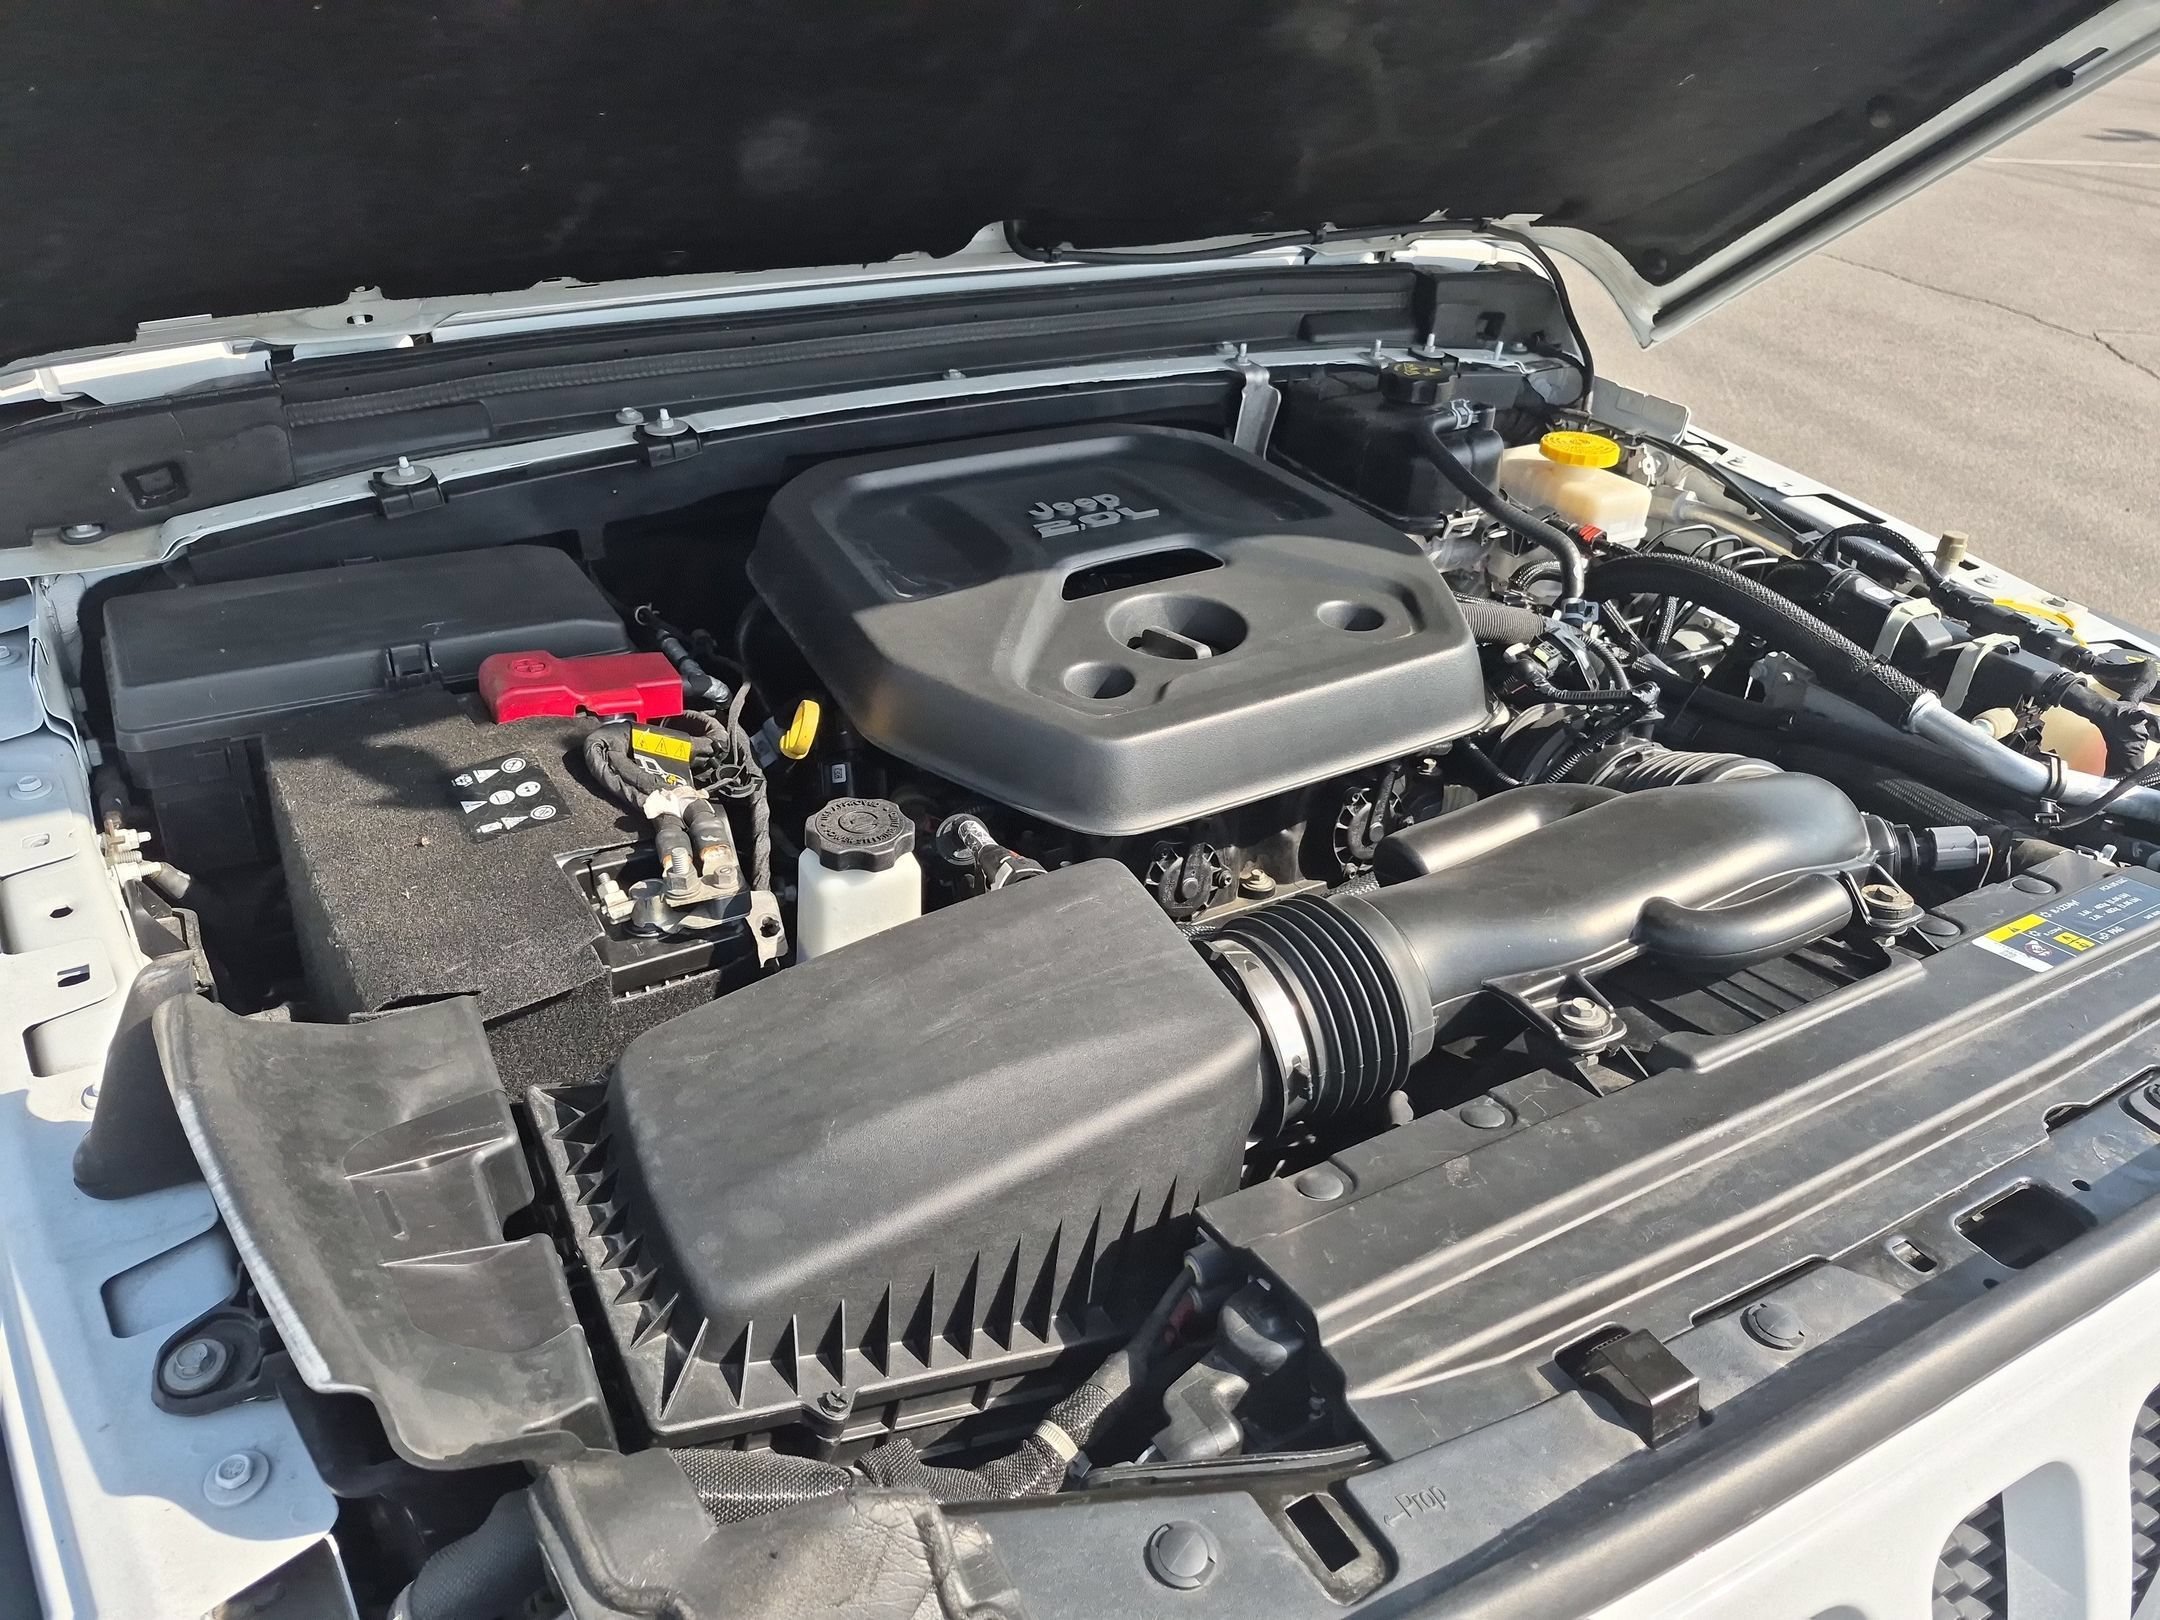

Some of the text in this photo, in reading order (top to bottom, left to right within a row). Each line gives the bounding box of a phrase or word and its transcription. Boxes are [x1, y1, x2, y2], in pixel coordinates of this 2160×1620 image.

[1028, 493, 1121, 520] Jeep
[1032, 507, 1160, 538] 2.0L
[1394, 1485, 1447, 1519] Prop
